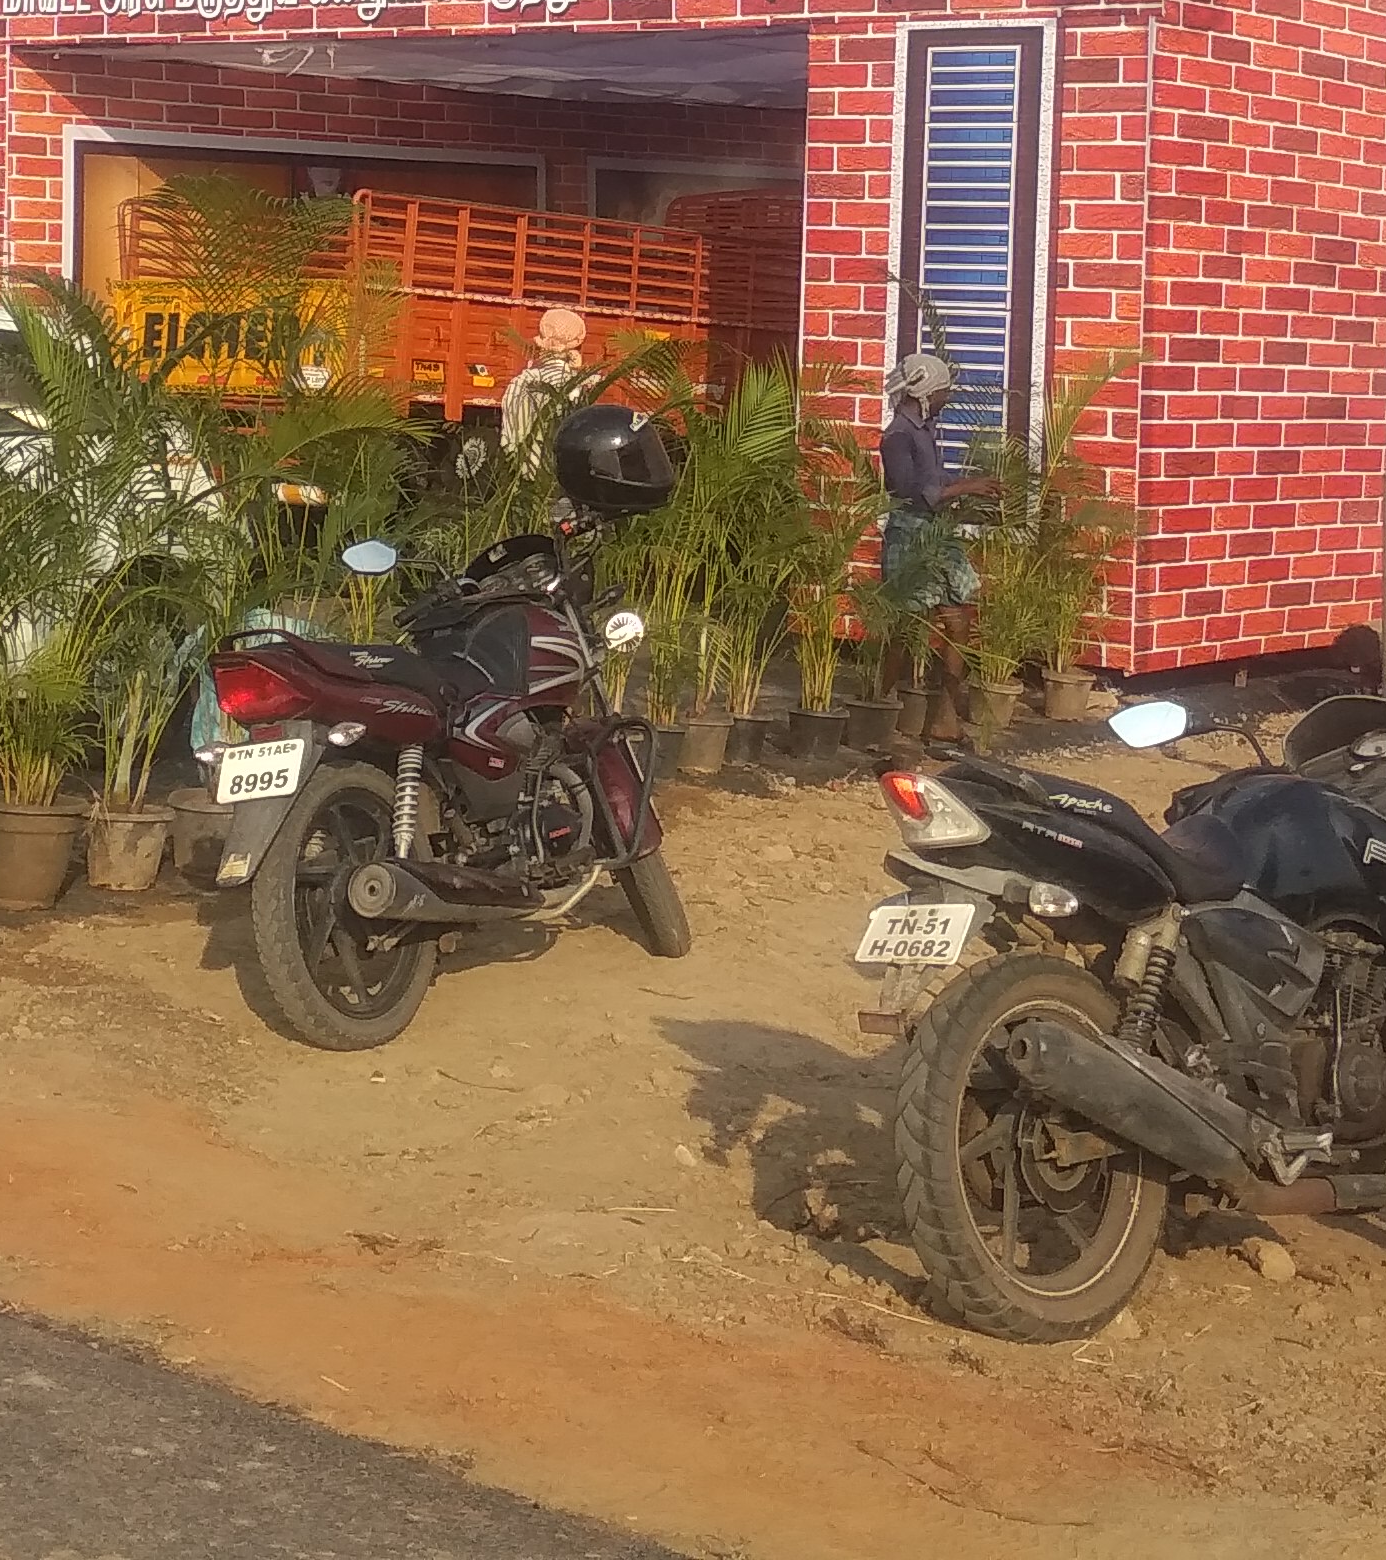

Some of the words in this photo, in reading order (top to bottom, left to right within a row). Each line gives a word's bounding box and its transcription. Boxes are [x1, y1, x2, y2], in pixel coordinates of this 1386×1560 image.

[237, 747, 254, 760] TN
[257, 742, 291, 758] 51AE
[229, 768, 290, 795] 8995
[1049, 793, 1113, 813] Apache
[886, 917, 951, 935] TN-51
[867, 939, 951, 958] H-0682
